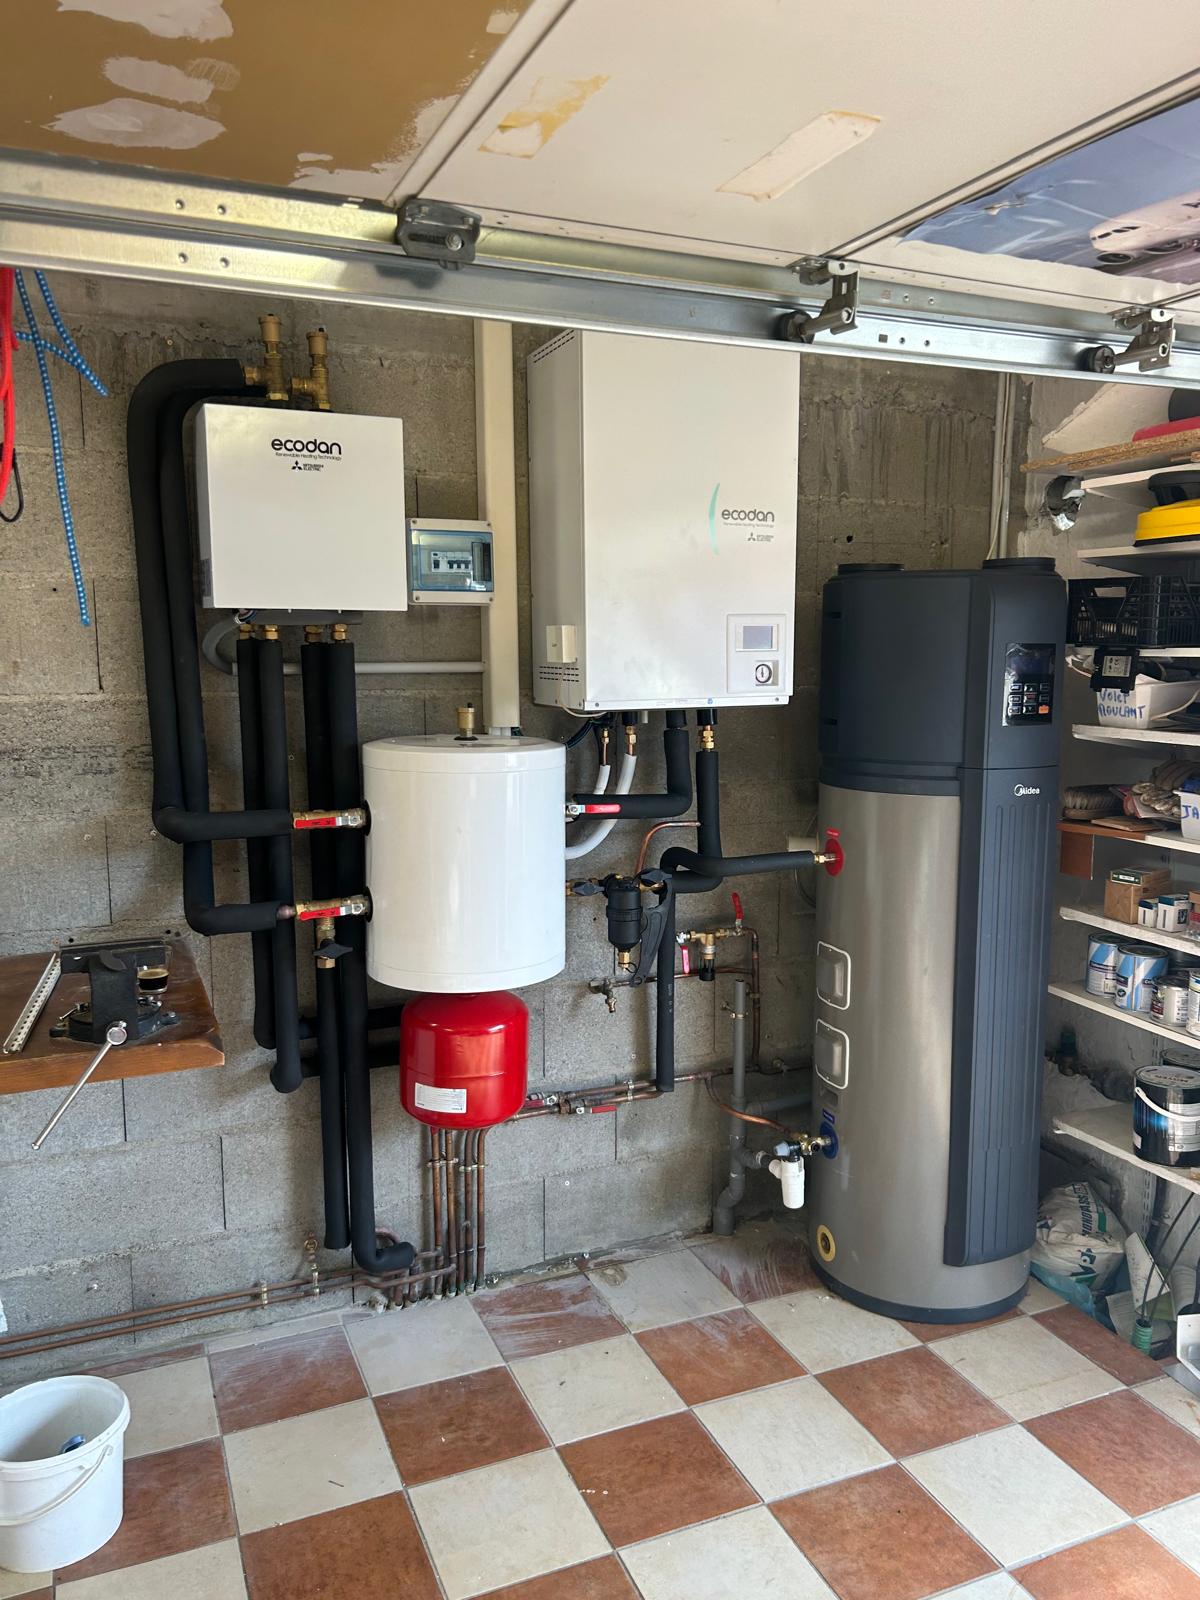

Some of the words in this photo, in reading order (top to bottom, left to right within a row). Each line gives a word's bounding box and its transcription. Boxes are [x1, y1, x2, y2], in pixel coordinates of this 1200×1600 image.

[271, 439, 342, 455] ecodan
[721, 508, 775, 523] ecodan
[1014, 784, 1040, 796] Midea
